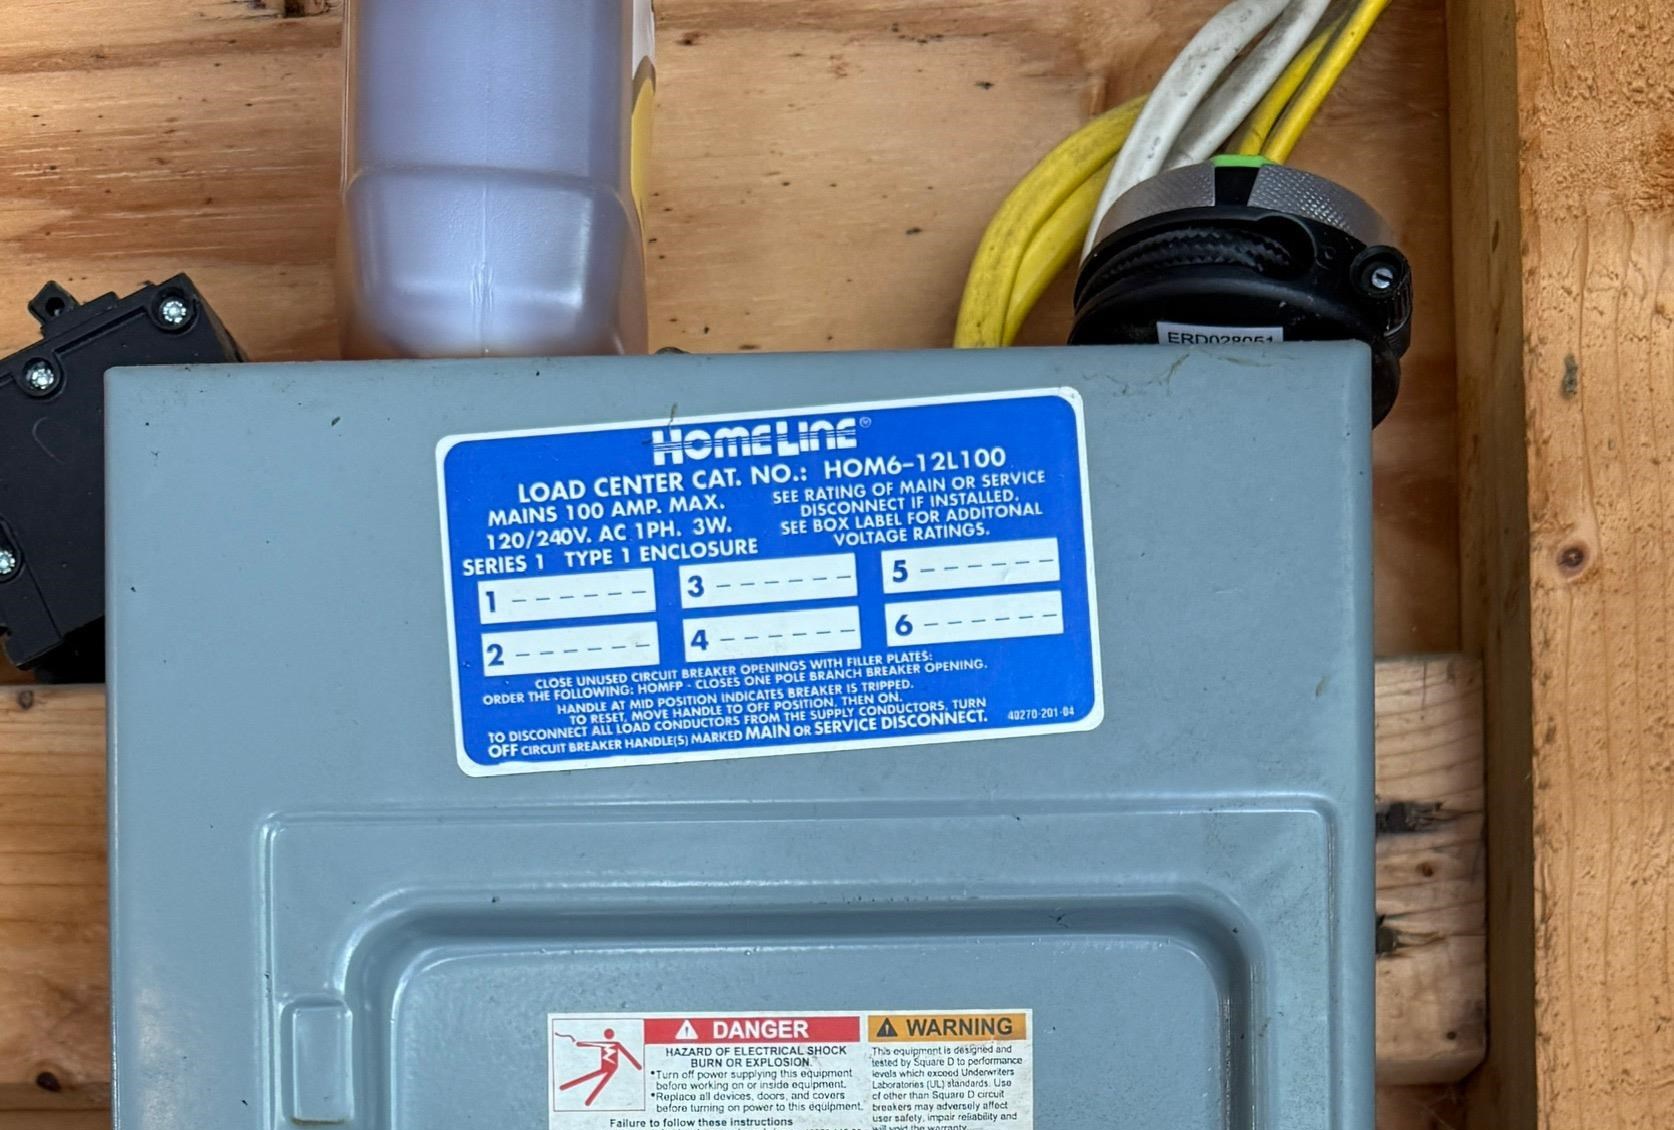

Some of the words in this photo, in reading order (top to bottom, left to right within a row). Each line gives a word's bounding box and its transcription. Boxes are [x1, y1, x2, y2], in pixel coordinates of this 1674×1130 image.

[517, 478, 586, 503] LOAD
[592, 471, 684, 498] CENTER
[691, 466, 742, 490] CAT.
[749, 462, 807, 485] NO.:
[823, 446, 1006, 479] HOM6-12L100
[771, 488, 799, 504] SEE
[803, 483, 867, 502] RATING
[870, 481, 893, 497] OF
[899, 476, 946, 494] MAIN
[950, 474, 976, 491] OR
[980, 469, 1045, 488] SERVICE
[487, 504, 558, 527] MAINS
[565, 501, 604, 521] 100
[610, 497, 662, 517] AMP.
[668, 493, 725, 513] MAX.
[799, 496, 905, 517] DISCONNECT
[910, 494, 924, 509] IF
[929, 488, 1019, 508] INSTALLED.
[779, 518, 807, 536] SEE
[812, 516, 850, 533] BOX
[854, 512, 902, 529] LABEL
[906, 509, 940, 525] FOR
[945, 501, 1043, 522] ADDITONAL
[485, 525, 592, 550] 120/240V.
[597, 522, 627, 542] AC
[634, 519, 682, 540] 1PH.
[692, 515, 732, 536] 3W.
[832, 526, 908, 546] VOLTAGE
[912, 521, 990, 541] RATINGS.
[461, 553, 527, 577] SERIES
[534, 552, 544, 570] 1
[563, 547, 613, 567] TYPE
[621, 546, 630, 563] 1
[638, 537, 758, 562] ENCLOSURE
[893, 560, 908, 582] 5
[688, 576, 704, 597] 3
[486, 591, 495, 612] 1
[895, 615, 911, 635] 6
[691, 630, 708, 650] 4
[487, 644, 504, 666] 2
[533, 676, 573, 690] CLOSE
[575, 672, 628, 687] UNUSED
[630, 668, 677, 683] CIRCUIT
[680, 664, 737, 679] BREAKER
[739, 659, 807, 675] OPENINGS
[808, 656, 843, 670] WITH
[845, 654, 883, 667] FILLER
[885, 649, 932, 664] PLATES:
[481, 691, 525, 706] ORDER
[526, 689, 550, 702] THE
[552, 683, 634, 701] FOLLOWING:
[636, 679, 684, 695] HOMFP
[694, 675, 741, 690] CLOSES
[743, 673, 771, 686] ONE
[774, 670, 805, 684] POLE
[808, 667, 862, 682] BRANCH
[865, 662, 921, 677] BREAKER
[923, 658, 987, 673] OPENING.
[556, 700, 607, 715] HANDLE
[610, 699, 625, 711] AT
[628, 697, 654, 710] MID
[656, 693, 718, 708] POSITION
[720, 687, 784, 703] INDICATES
[786, 683, 842, 699] BREAKER
[845, 682, 858, 693] IS
[860, 678, 910, 692] TRIPPED.
[568, 713, 587, 725] TO
[589, 710, 627, 724] RESET,
[630, 708, 669, 721] MOVE
[671, 704, 722, 718] HANDLE
[725, 702, 743, 714] TO
[745, 700, 770, 713] OFF
[773, 696, 834, 711] POSITION,
[840, 693, 874, 706] THEN
[876, 690, 899, 704] ON.
[487, 731, 506, 744] TO
[507, 725, 587, 742] DISCONNECT
[590, 723, 613, 737] ALL
[615, 720, 651, 734] LOAD
[653, 714, 741, 731] CONDUCTORS
[742, 711, 781, 725] FROM
[782, 709, 806, 722] THE
[809, 706, 854, 721] SUPPLY
[857, 699, 945, 717] CONDUCTORS,
[951, 696, 987, 710] TURN
[1006, 705, 1075, 721] 40270-201-04
[486, 742, 519, 758] OFF
[519, 742, 566, 756] CIRCUIT
[567, 738, 622, 753] BREAKER
[623, 734, 689, 749] HANDLE(S)
[690, 728, 743, 744] MARKED
[744, 722, 791, 741] MAIN
[792, 724, 812, 737] OR
[813, 716, 877, 736] SERVICE
[879, 708, 988, 730] DISCONNECT.
[712, 1018, 809, 1039] DANGER
[905, 1015, 1013, 1037] WARNING
[664, 1046, 713, 1057] HAZARD
[714, 1046, 731, 1057] OF
[733, 1044, 805, 1056] ELECTRICAL
[805, 1044, 847, 1056] SHOCK
[689, 1057, 723, 1069] BURN
[724, 1057, 742, 1068] OR
[744, 1055, 816, 1068] EXPLOSION.
[655, 1068, 679, 1080] Turn
[680, 1068, 695, 1079] off
[696, 1070, 728, 1081] power
[729, 1068, 778, 1081] supplying
[779, 1068, 798, 1078] this
[799, 1067, 853, 1080] equipment
[655, 1079, 688, 1091] before
[688, 1079, 729, 1092] working
[730, 1081, 745, 1090] on
[745, 1081, 757, 1090] or
[756, 1077, 790, 1090] inside
[608, 1117, 647, 1128] Failure
[648, 1118, 660, 1128] to
[662, 1117, 696, 1128] follow
[696, 1116, 727, 1127] these
[729, 1115, 794, 1127] instructions
